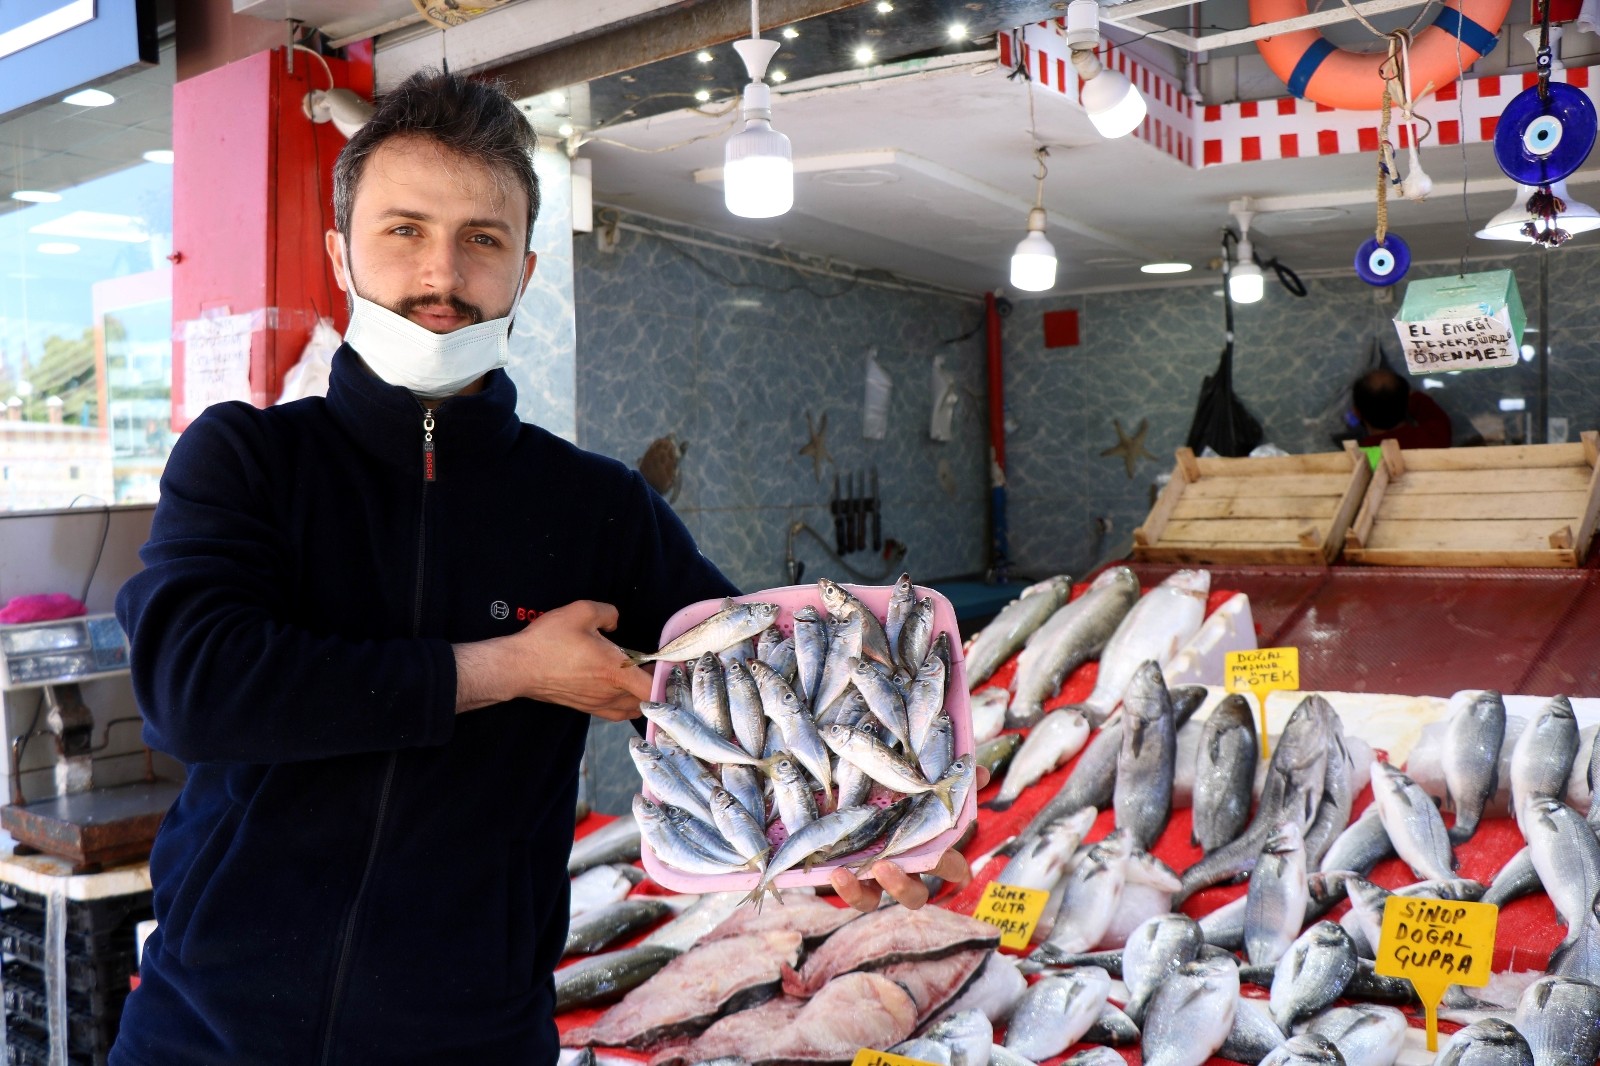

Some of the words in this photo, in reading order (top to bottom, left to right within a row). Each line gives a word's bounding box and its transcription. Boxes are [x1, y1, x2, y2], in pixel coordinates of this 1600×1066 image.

[1408, 324, 1431, 337] EL
[1413, 347, 1512, 364] ÖDENMEZ
[1233, 670, 1295, 688] KÖTEK
[991, 901, 1026, 914] OLTA
